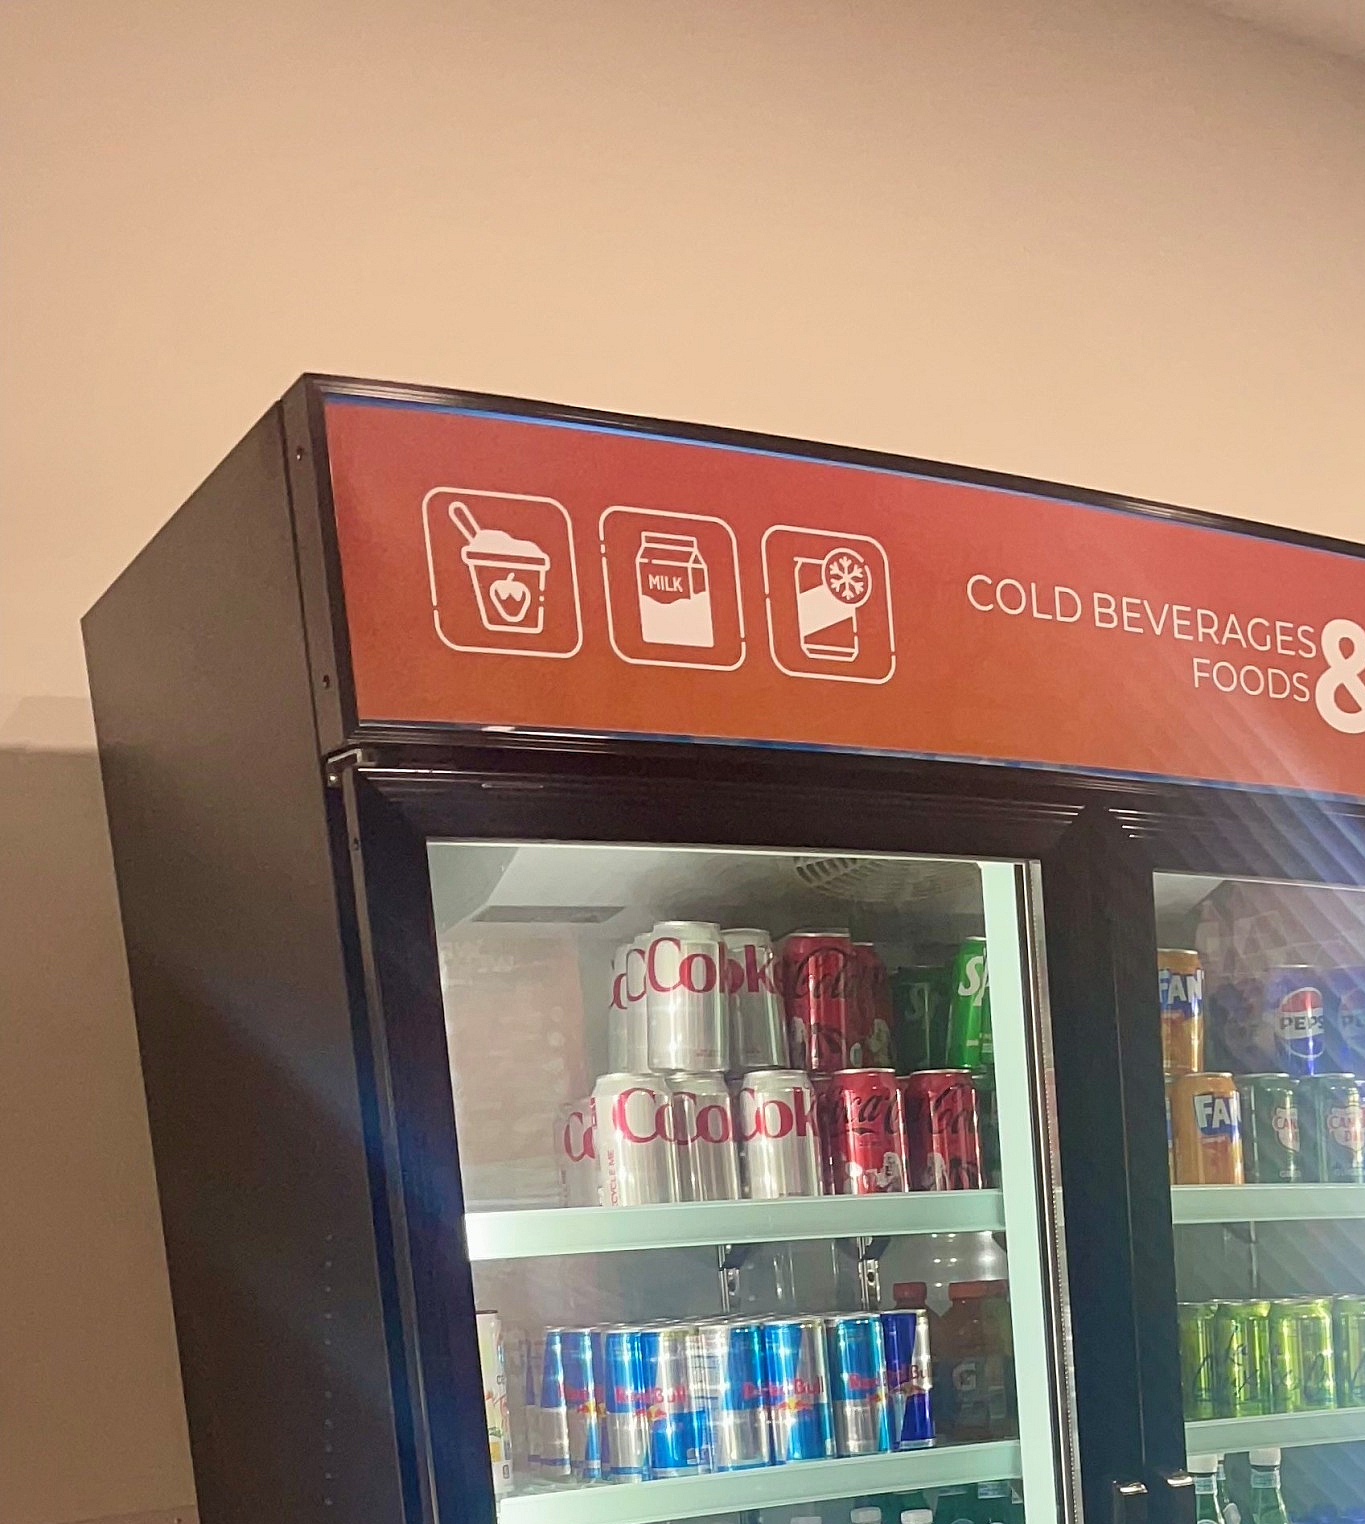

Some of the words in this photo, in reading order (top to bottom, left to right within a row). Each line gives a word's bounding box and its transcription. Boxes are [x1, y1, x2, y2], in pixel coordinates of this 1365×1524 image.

[647, 573, 684, 594] MILK
[966, 574, 1082, 623] COLD
[1093, 592, 1317, 658] BEVERAGES
[1193, 657, 1310, 702] FOODS
